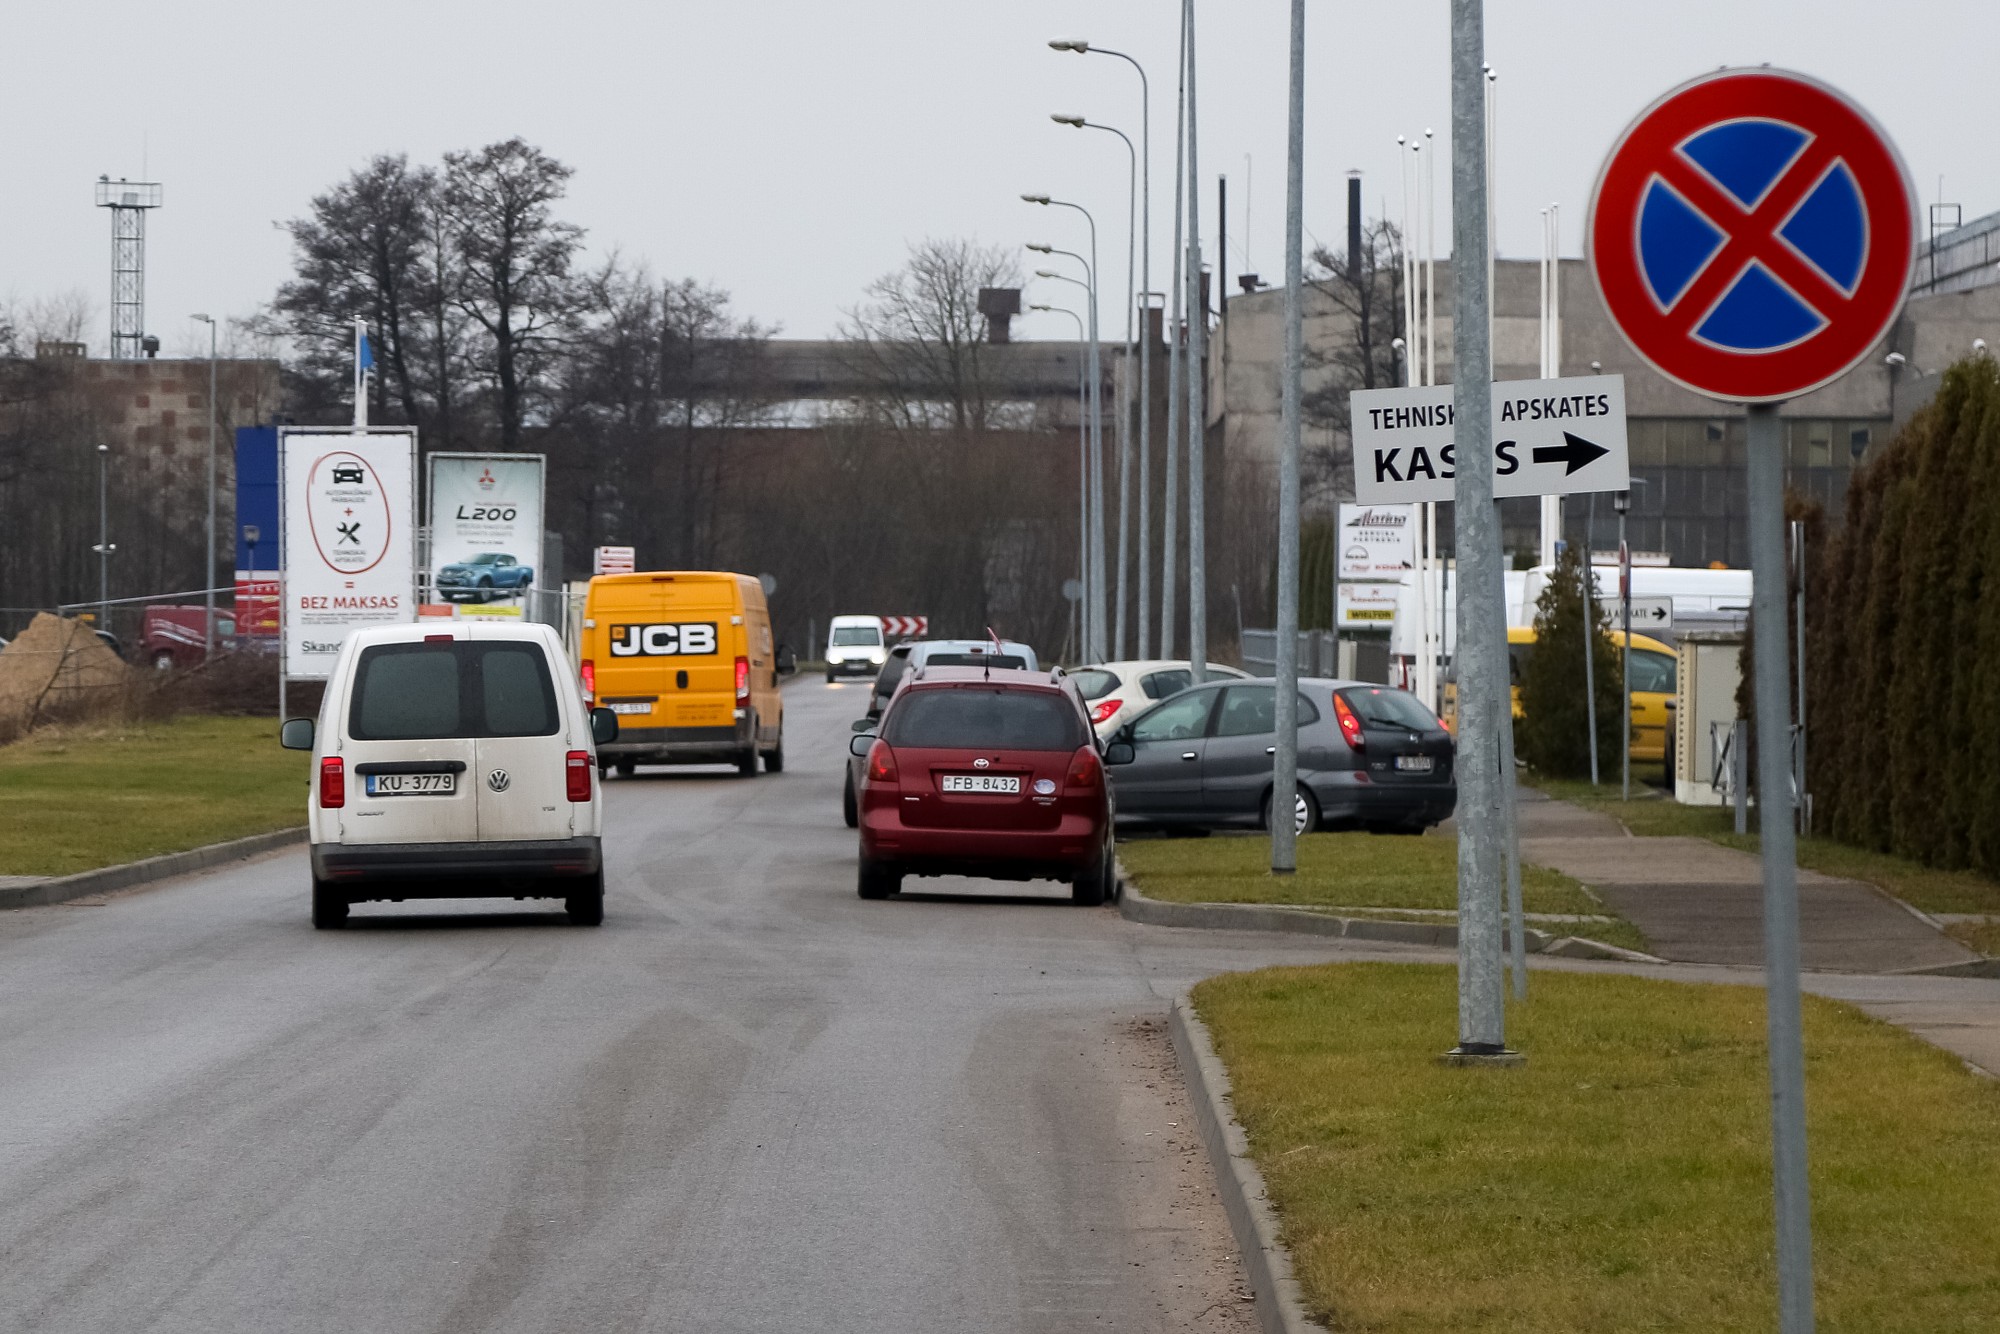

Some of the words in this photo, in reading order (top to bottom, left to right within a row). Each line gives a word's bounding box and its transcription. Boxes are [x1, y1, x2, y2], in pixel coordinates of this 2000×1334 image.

[1501, 394, 1609, 421] APSKATES
[1374, 440, 1519, 483] KASS
[456, 504, 517, 521] L200
[301, 596, 329, 609] BEZ
[333, 595, 399, 609] MAKSAS
[611, 624, 716, 656] JCB
[379, 775, 452, 791] KU-3779
[953, 777, 1018, 791] FB-8432
